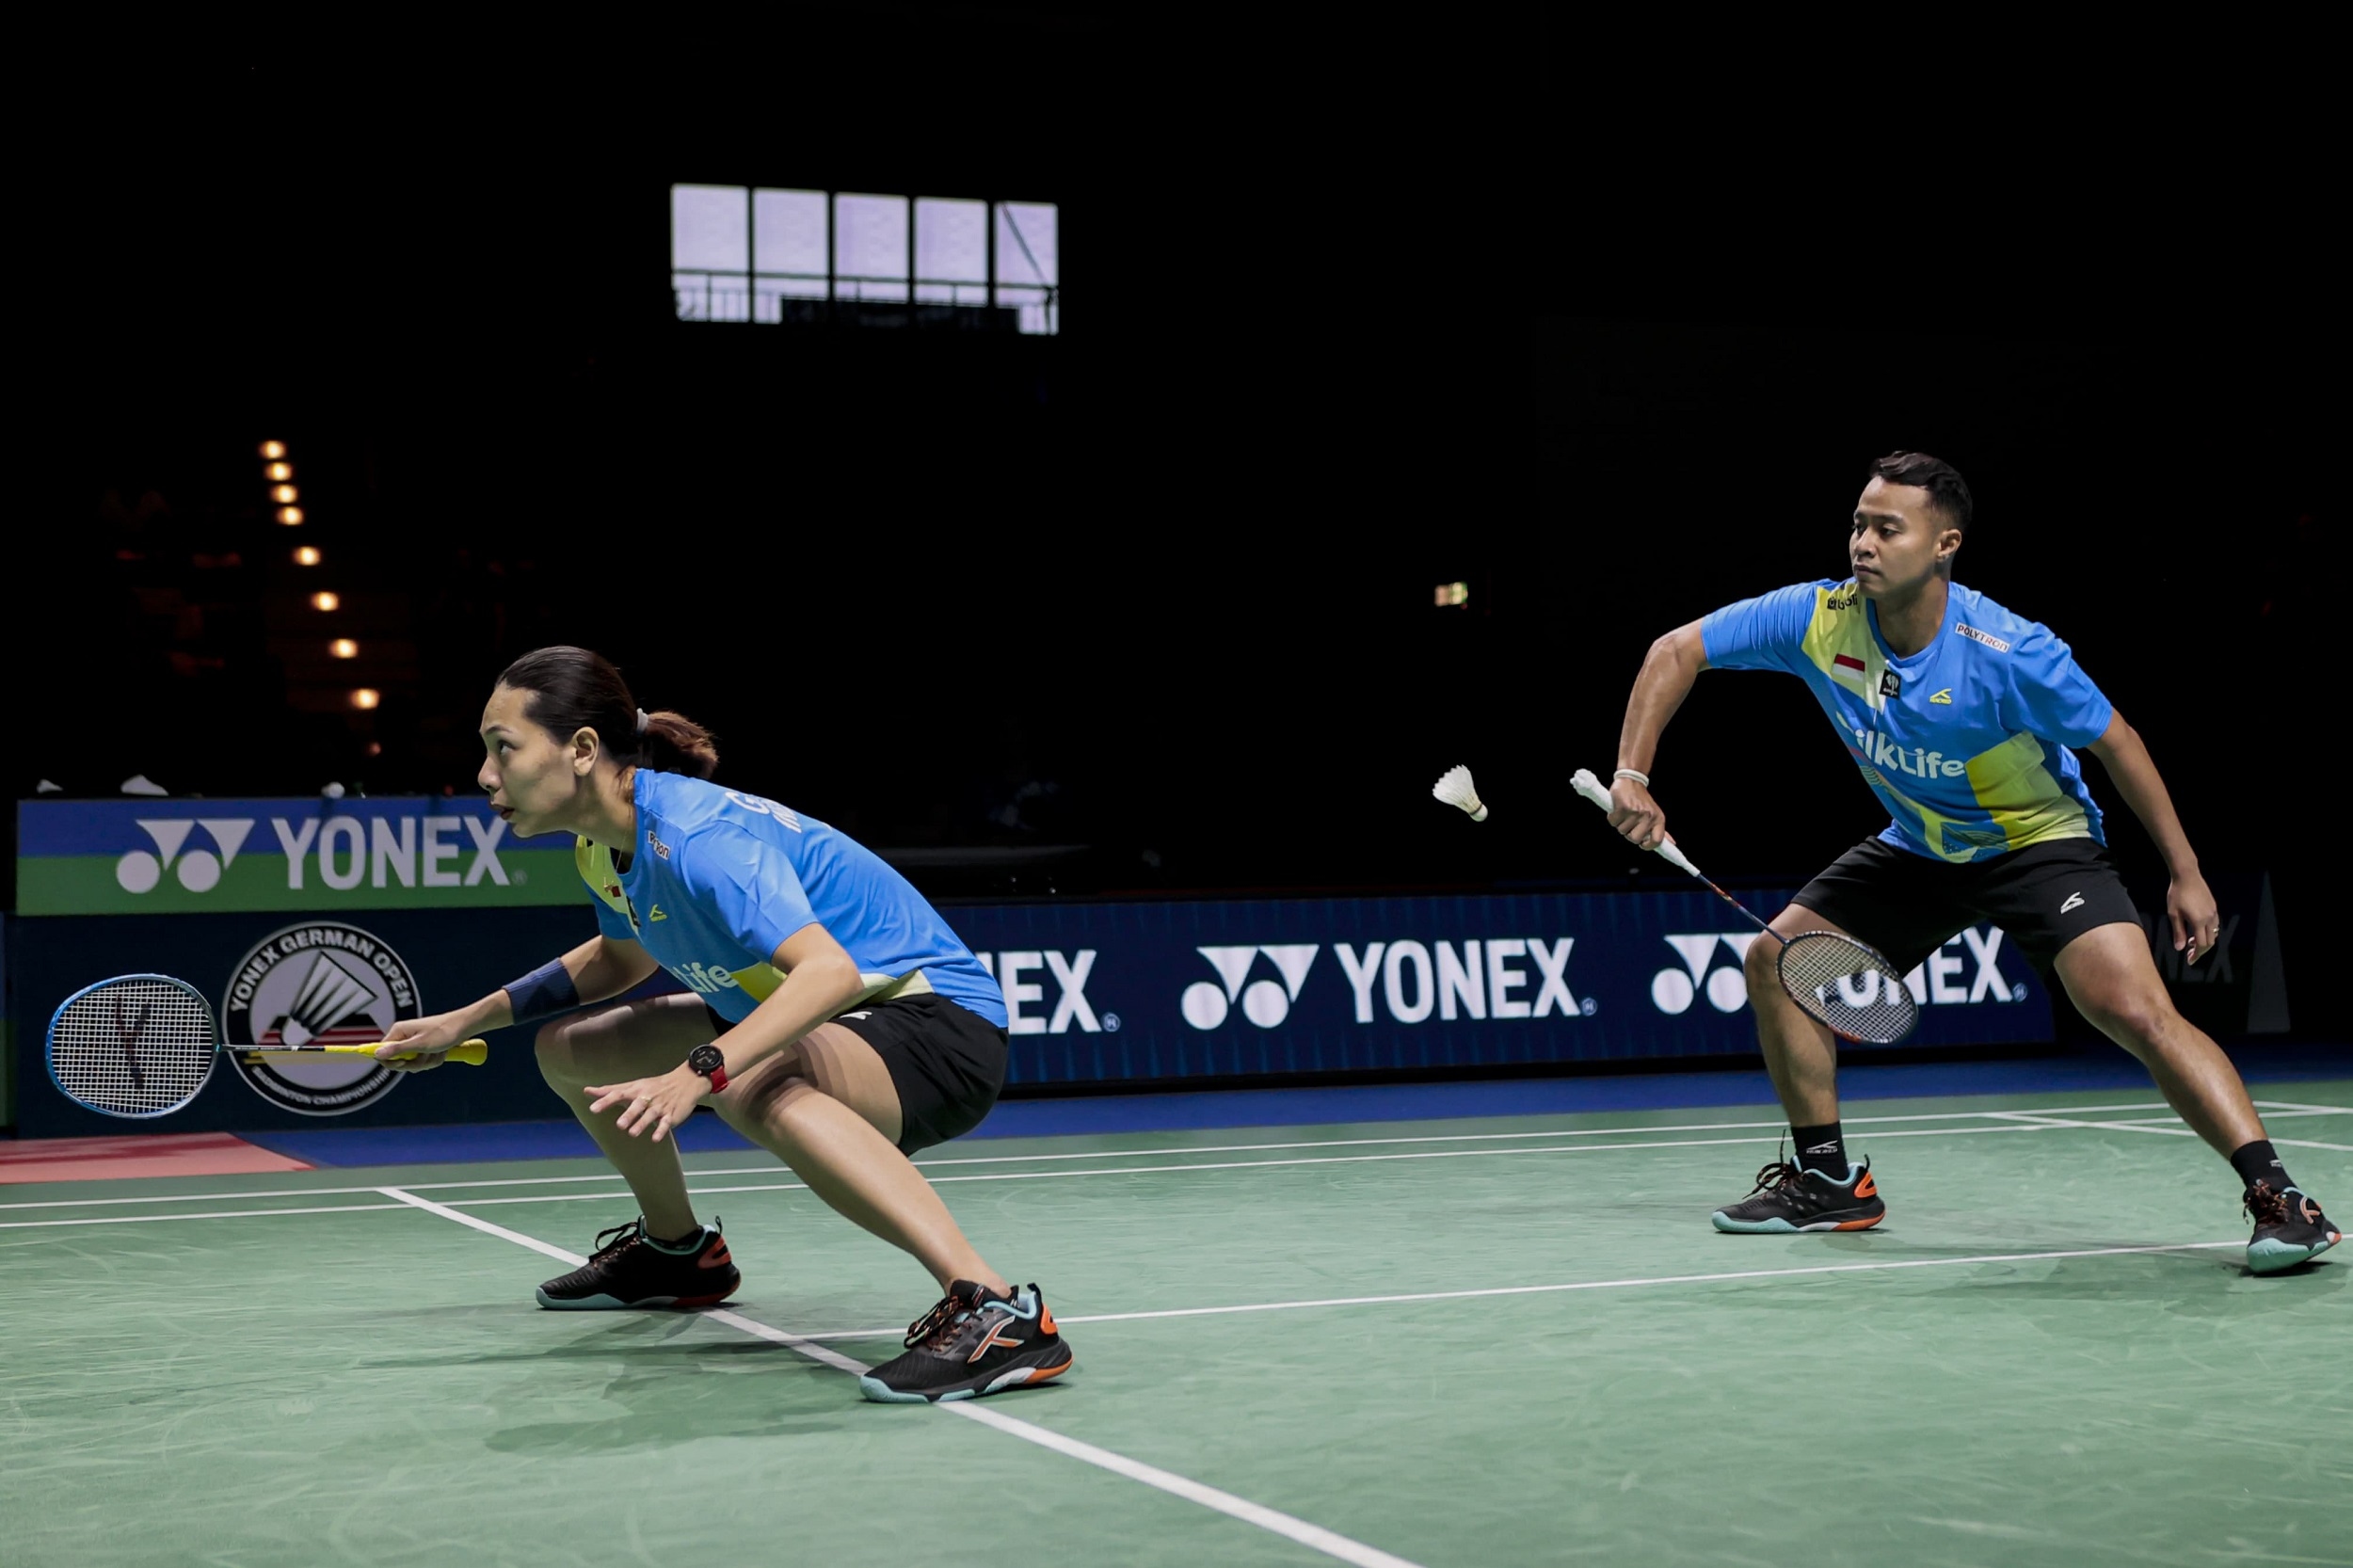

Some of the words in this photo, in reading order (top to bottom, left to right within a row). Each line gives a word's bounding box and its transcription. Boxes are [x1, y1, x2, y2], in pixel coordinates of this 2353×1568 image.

[1957, 624, 2009, 651] POLYTRON
[1836, 711, 1966, 780] ilkLife
[271, 815, 510, 890] YONEX
[229, 945, 280, 1013] YONEX
[279, 928, 376, 958] GERMAN
[372, 951, 414, 1009] OPEN
[1333, 937, 1581, 1024] YONEX
